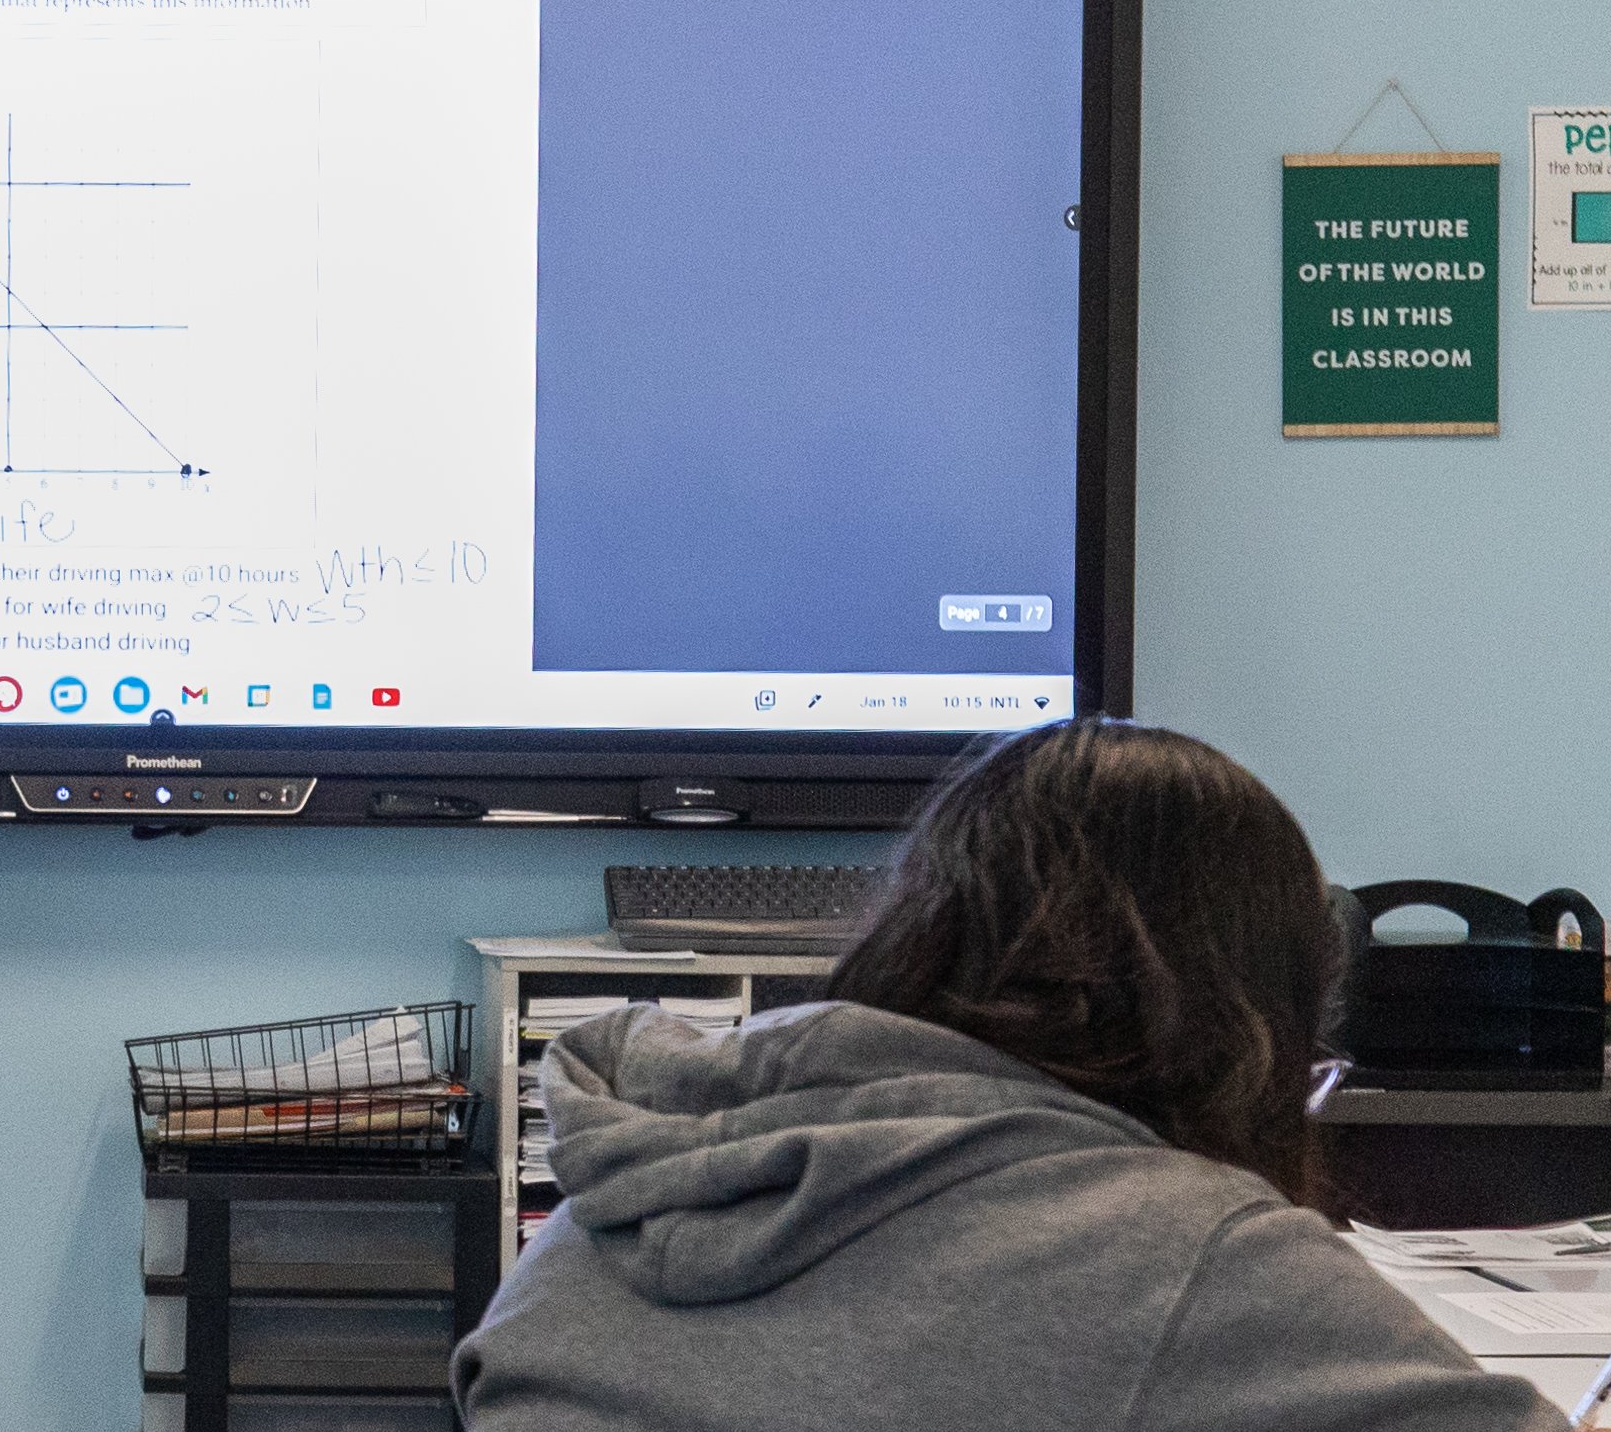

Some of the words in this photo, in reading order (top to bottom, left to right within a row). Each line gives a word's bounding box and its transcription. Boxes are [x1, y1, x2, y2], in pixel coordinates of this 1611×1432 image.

[1547, 160, 1571, 176] the
[1574, 160, 1604, 176] total
[1314, 220, 1363, 240] THE
[1370, 218, 1469, 239] FUTURE
[1298, 262, 1333, 283] OF
[1336, 262, 1386, 282] THE
[1391, 261, 1486, 282] WORLD
[1538, 264, 1561, 277] Add
[1562, 266, 1578, 278] up
[1579, 264, 1594, 276] all
[1594, 263, 1608, 277] of
[1331, 307, 1355, 327] IS
[1362, 307, 1389, 327] IN
[1395, 306, 1453, 326] THIS
[1312, 348, 1472, 369] CLASSROOM
[48, 563, 122, 586] driving
[128, 568, 175, 583] max
[238, 565, 300, 583] hours
[4, 596, 33, 615] for
[41, 596, 87, 616] wife
[93, 598, 168, 622] driving
[947, 606, 980, 623] Page
[15, 631, 111, 651] husband
[117, 632, 191, 656] driving
[860, 696, 886, 709] Jan
[890, 696, 908, 709] 18
[943, 696, 983, 709] 10:15
[126, 755, 202, 771] Promethean
